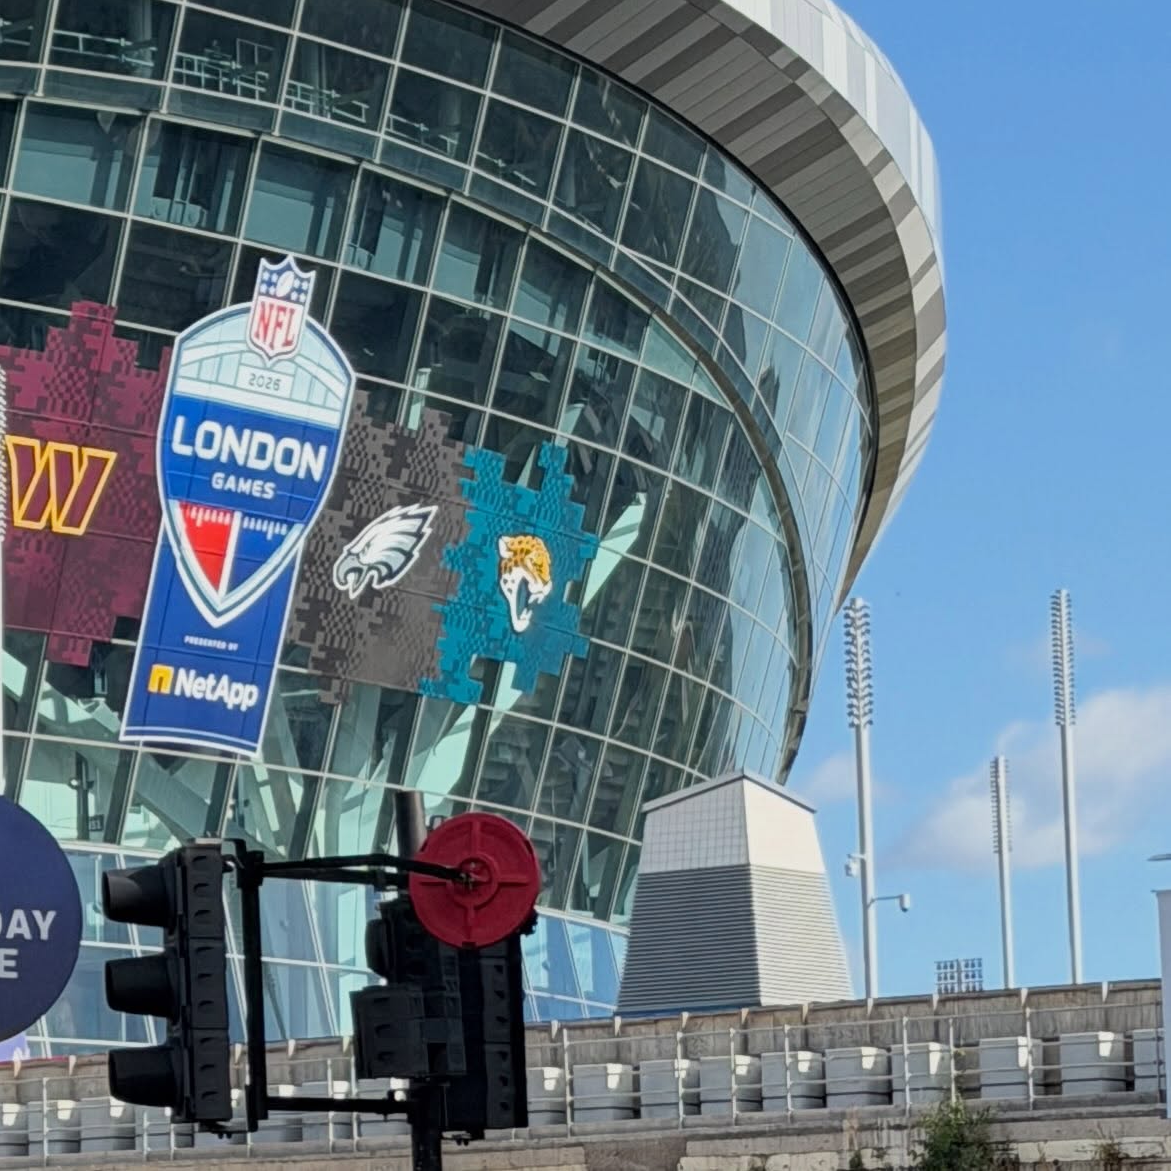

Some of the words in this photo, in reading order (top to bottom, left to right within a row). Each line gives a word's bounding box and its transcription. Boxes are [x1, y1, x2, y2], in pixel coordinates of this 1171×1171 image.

[254, 300, 296, 349] NFL
[248, 372, 282, 392] 2026
[171, 415, 328, 483] LONDON
[211, 471, 277, 500] GAMES
[174, 667, 259, 711] NetApp
